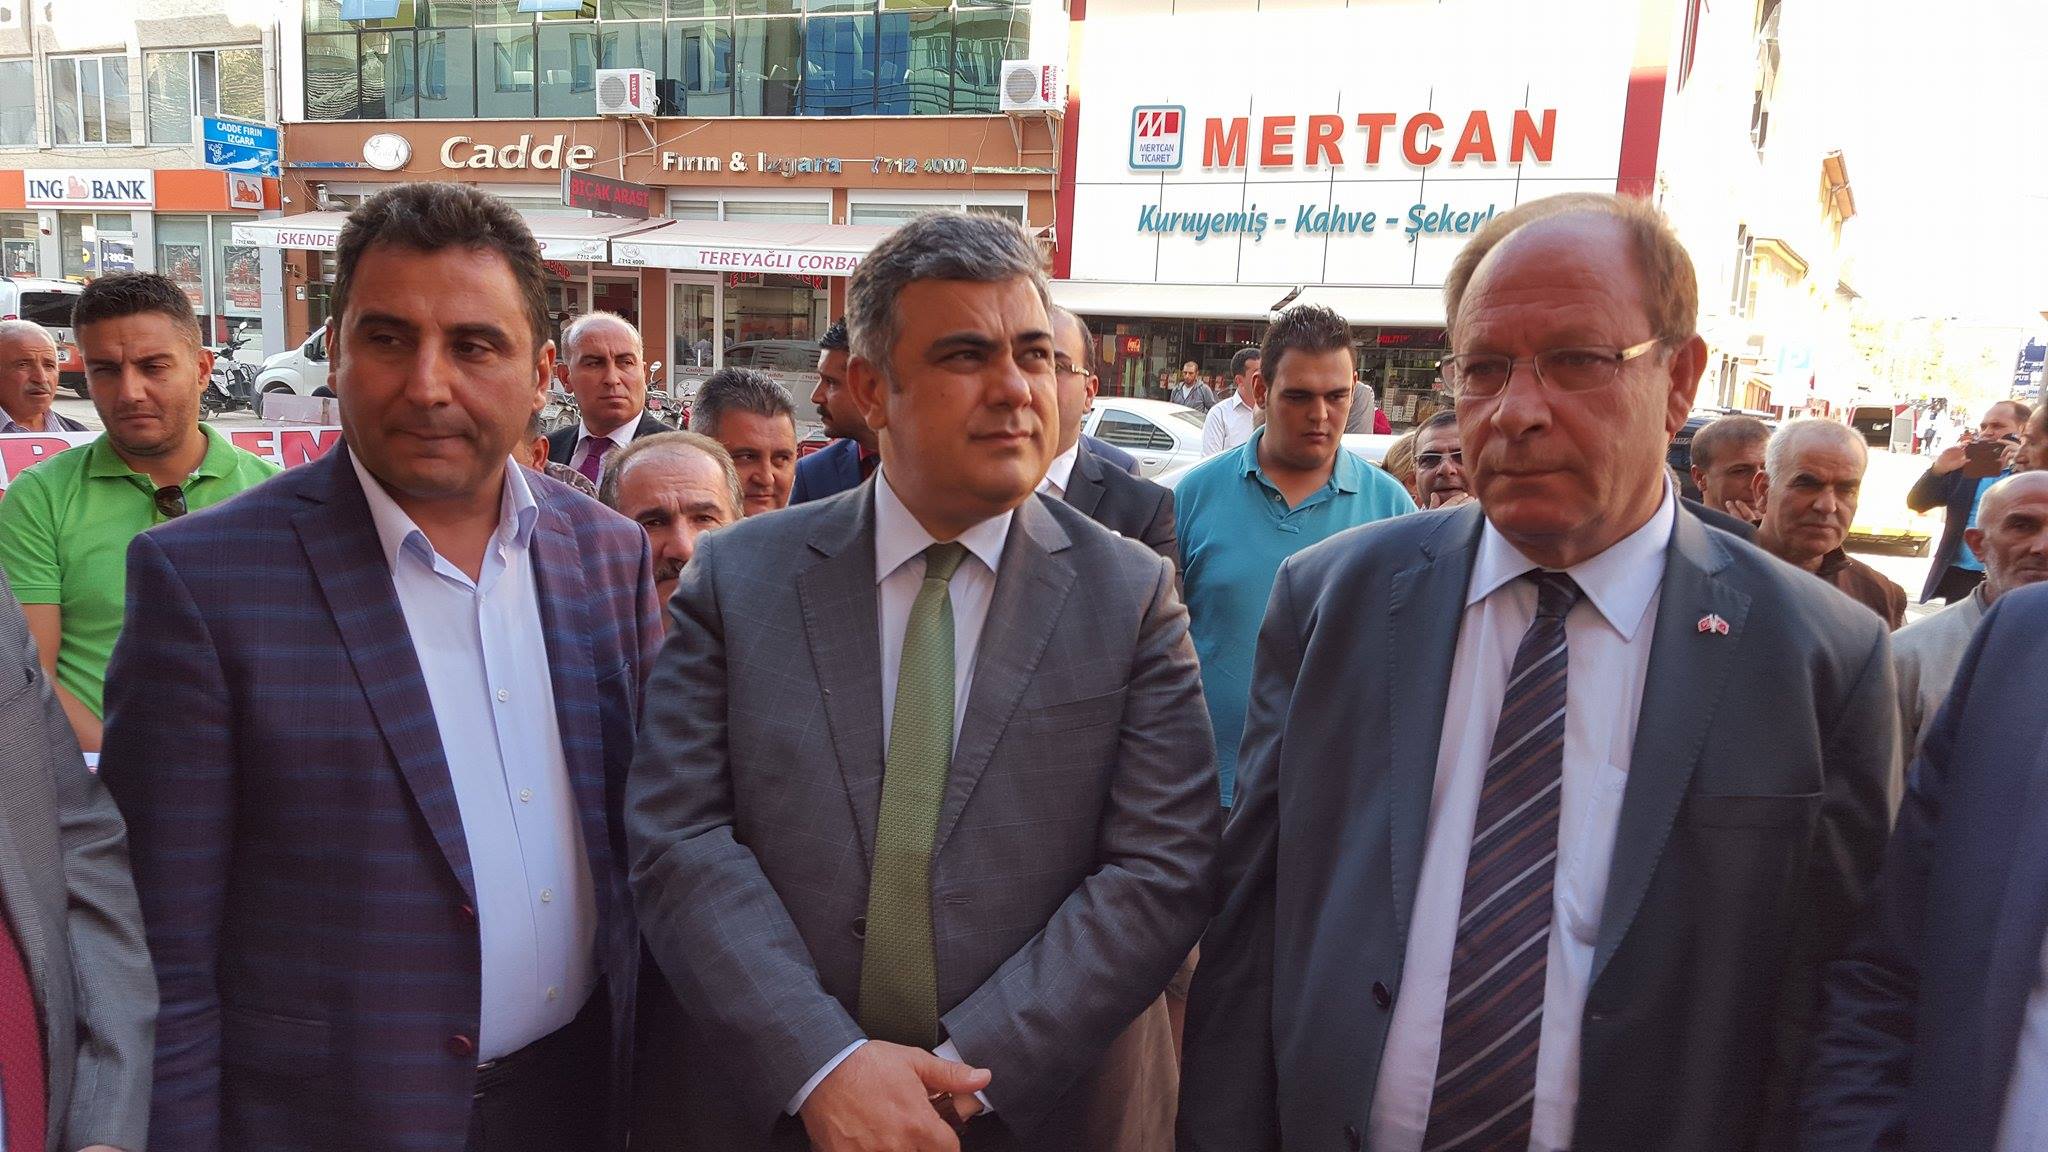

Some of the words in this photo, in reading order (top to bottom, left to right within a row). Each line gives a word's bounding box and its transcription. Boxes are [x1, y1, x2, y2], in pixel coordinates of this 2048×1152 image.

[217, 122, 243, 134] CADDE
[1201, 108, 1557, 168] MERTCAN
[439, 133, 597, 170] Cadde
[1139, 143, 1175, 152] MERTCAN
[729, 151, 749, 172] &
[757, 151, 842, 179] Izgara
[923, 158, 968, 174] 4000
[29, 180, 64, 199] ING
[92, 180, 147, 200] BANK
[1138, 203, 1268, 243] Kuruyemiş
[1295, 203, 1377, 234] Kahve
[276, 230, 340, 247] İSKENDE
[699, 249, 792, 269] TEREYAĞLI
